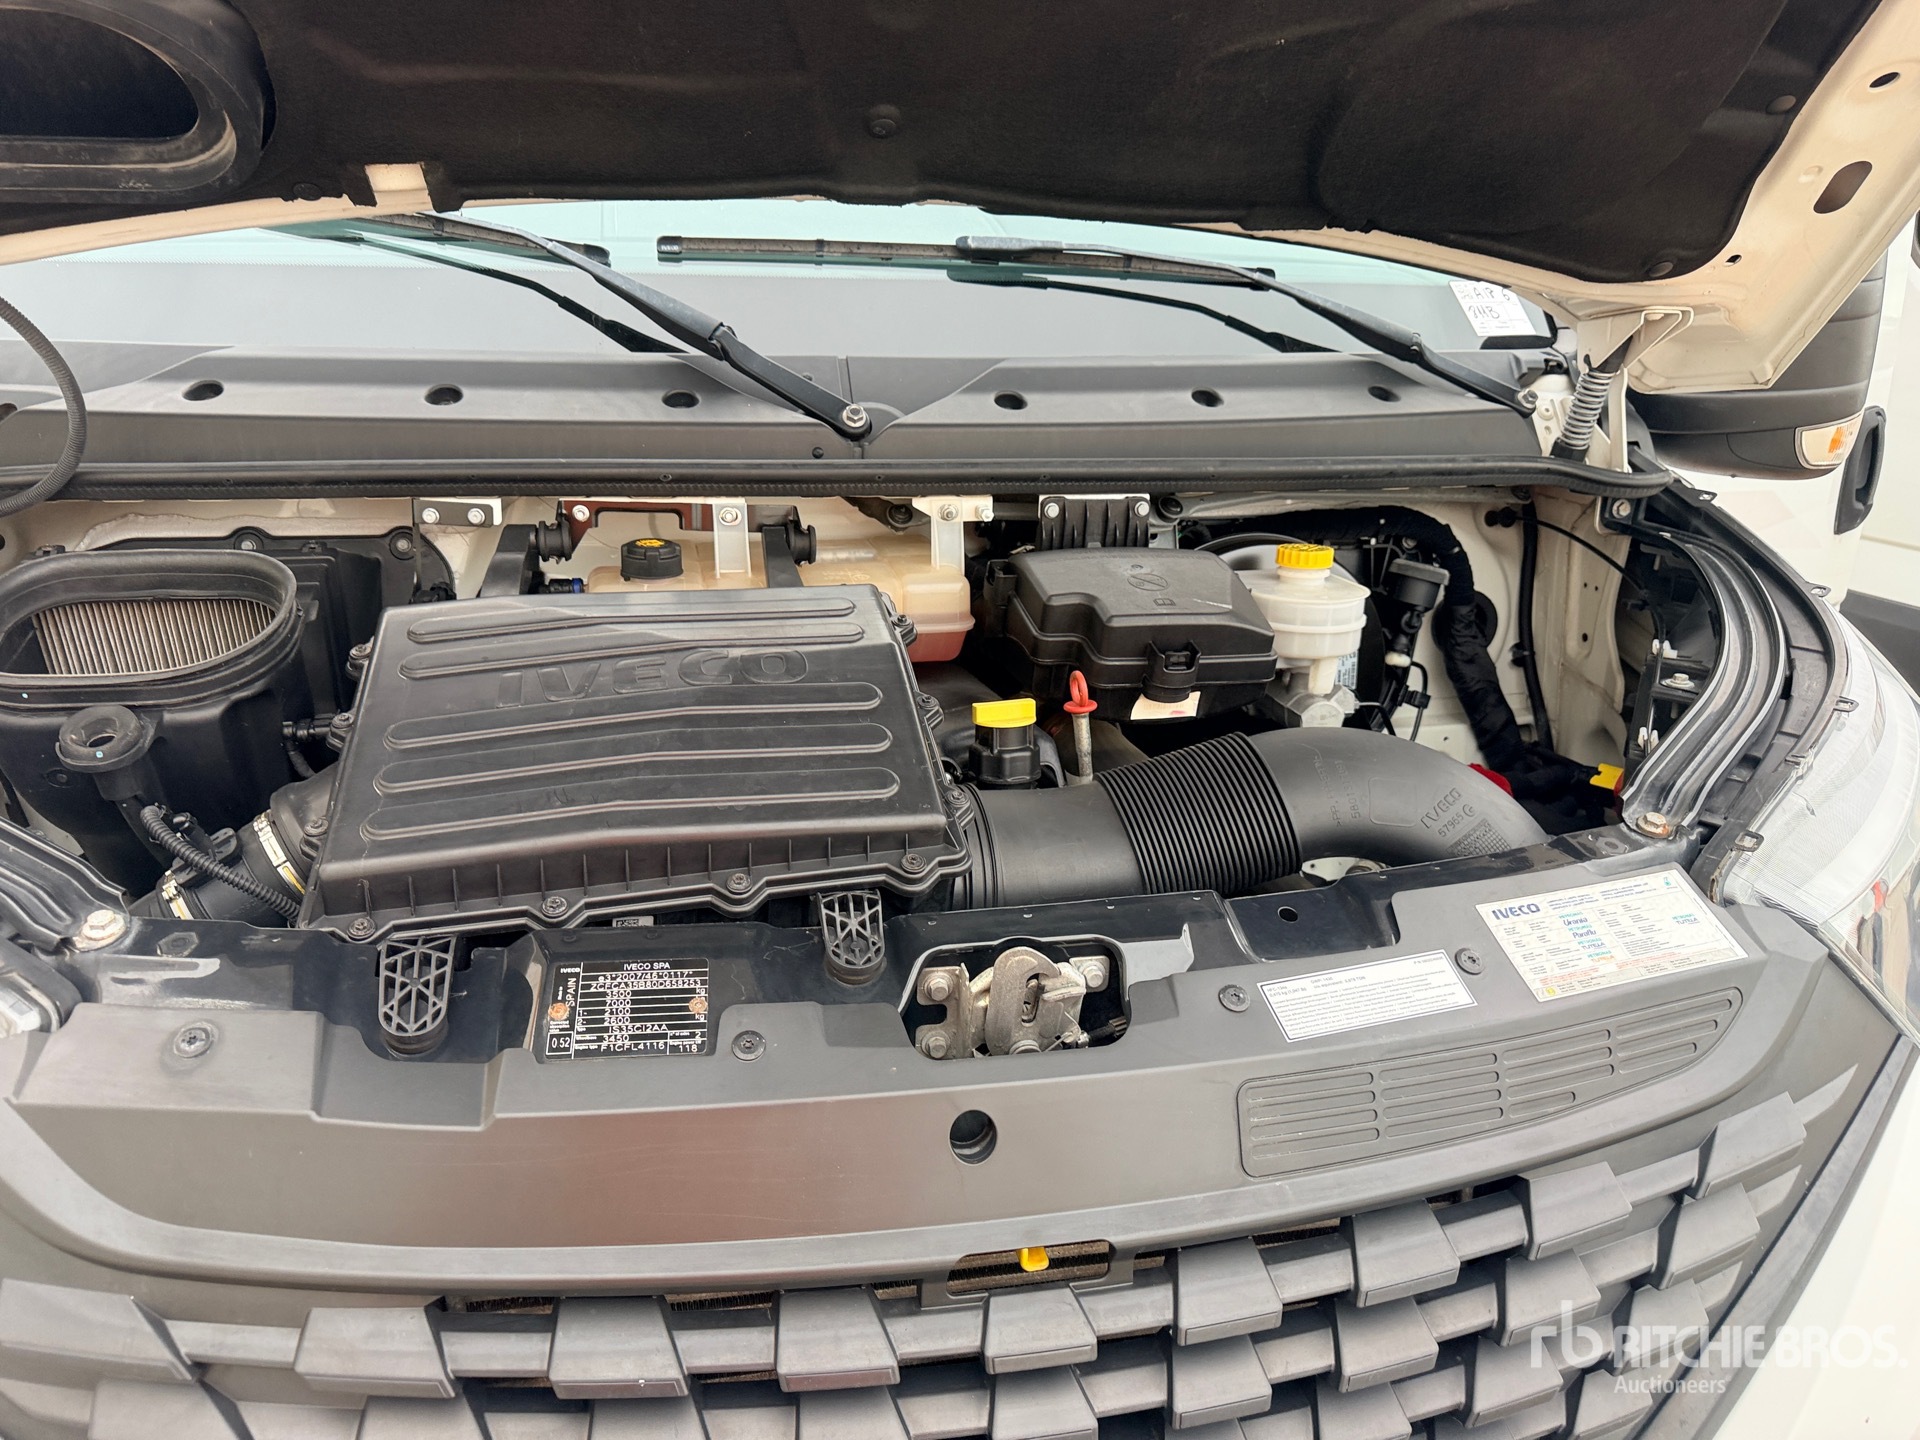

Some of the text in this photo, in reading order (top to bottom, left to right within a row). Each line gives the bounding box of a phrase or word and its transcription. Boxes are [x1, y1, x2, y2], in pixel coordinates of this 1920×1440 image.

[496, 650, 809, 709] IVECO
[1420, 788, 1462, 829] IVECO
[1437, 814, 1464, 838] 57965
[1491, 903, 1541, 920] IVECO
[1562, 917, 1589, 927] Urania
[1572, 929, 1597, 939] Paraflu
[623, 961, 671, 971] IVECO SPA
[565, 977, 577, 1007] SPAIN
[605, 987, 706, 999] 3500 kg
[605, 999, 632, 1008] 7000
[604, 1007, 631, 1017] 2100
[603, 1016, 631, 1026] 2600
[694, 1012, 705, 1021] kg
[602, 1034, 630, 1043] 3450
[695, 1030, 701, 1039] 2
[600, 1042, 666, 1053] F1CFL4116
[678, 1043, 698, 1053] 118
